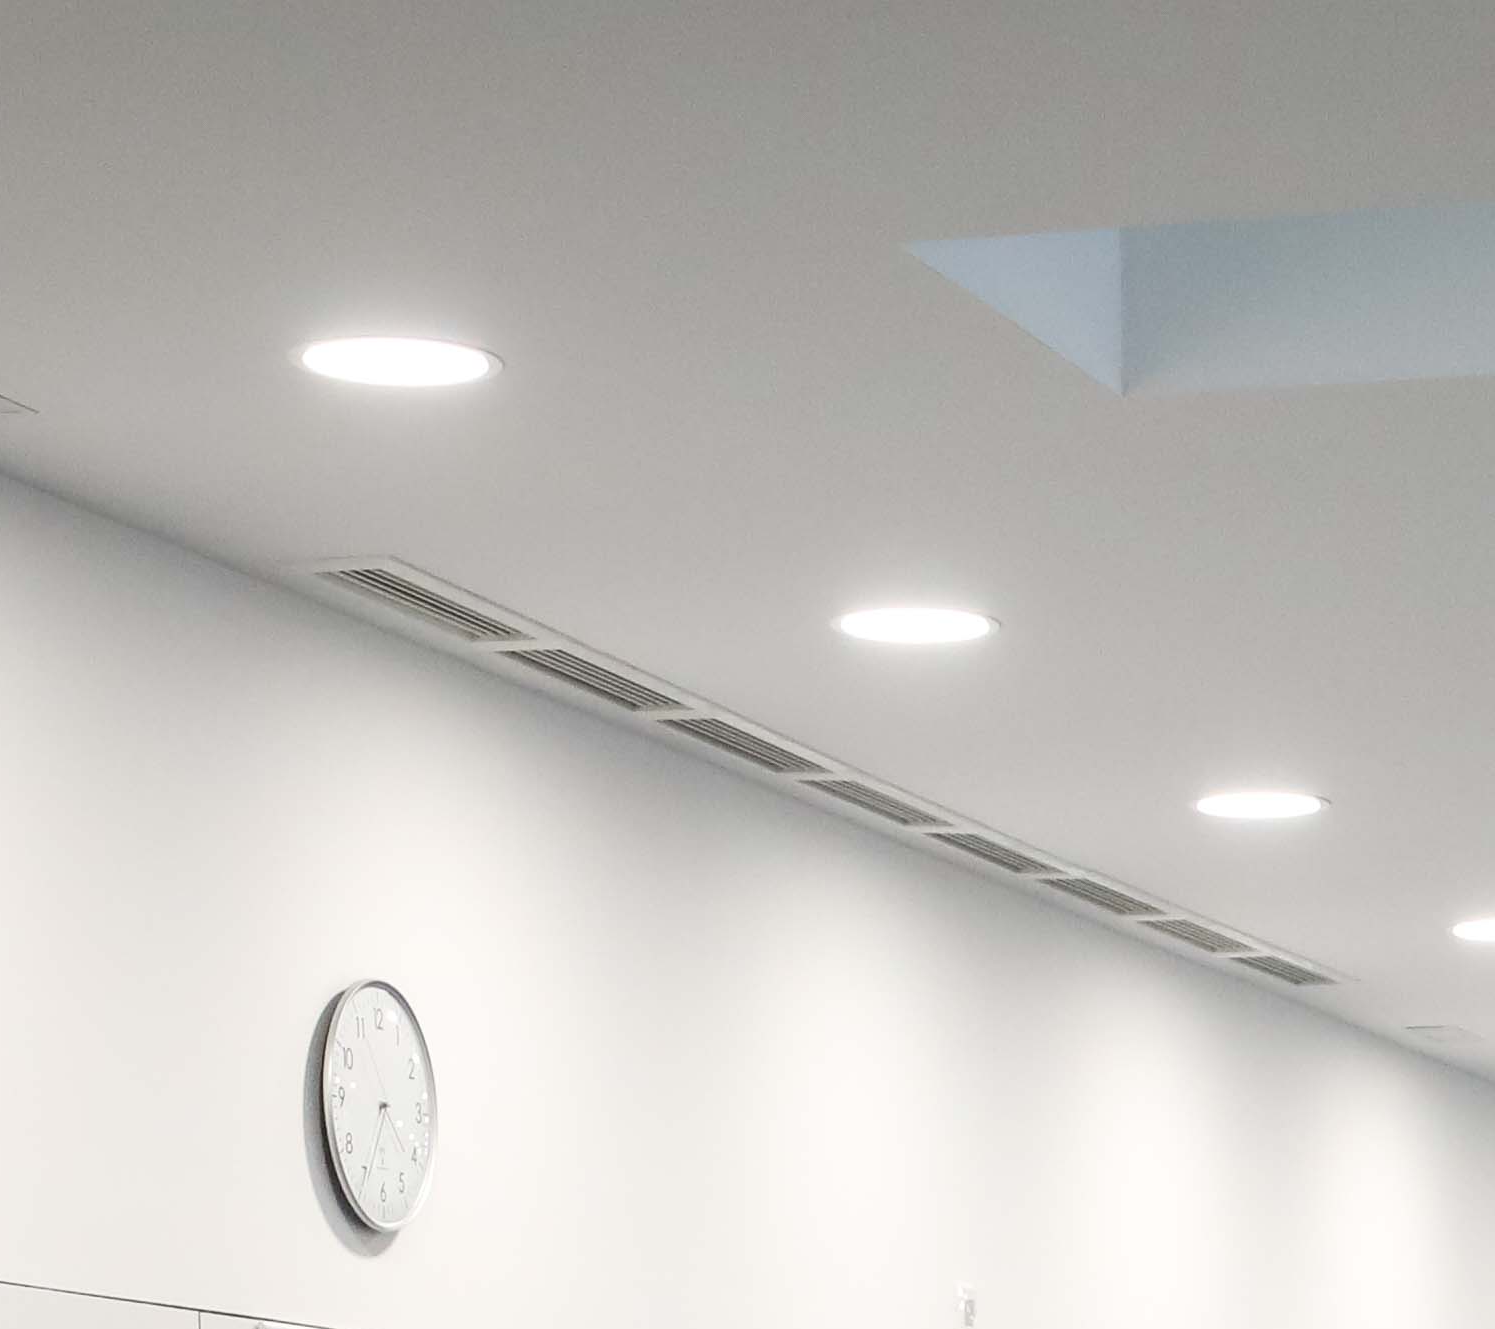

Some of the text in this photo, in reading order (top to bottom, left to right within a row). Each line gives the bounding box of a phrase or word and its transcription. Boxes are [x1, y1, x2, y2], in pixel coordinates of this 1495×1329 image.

[355, 1016, 365, 1039] 11
[372, 1007, 384, 1030] 12
[342, 1047, 354, 1070] 10
[409, 1058, 416, 1080] 2
[338, 1087, 346, 1107] 9
[416, 1102, 423, 1125] 3
[345, 1132, 354, 1154] 8
[411, 1147, 417, 1167] 4
[380, 1181, 387, 1203] 6
[398, 1172, 406, 1194] 5
